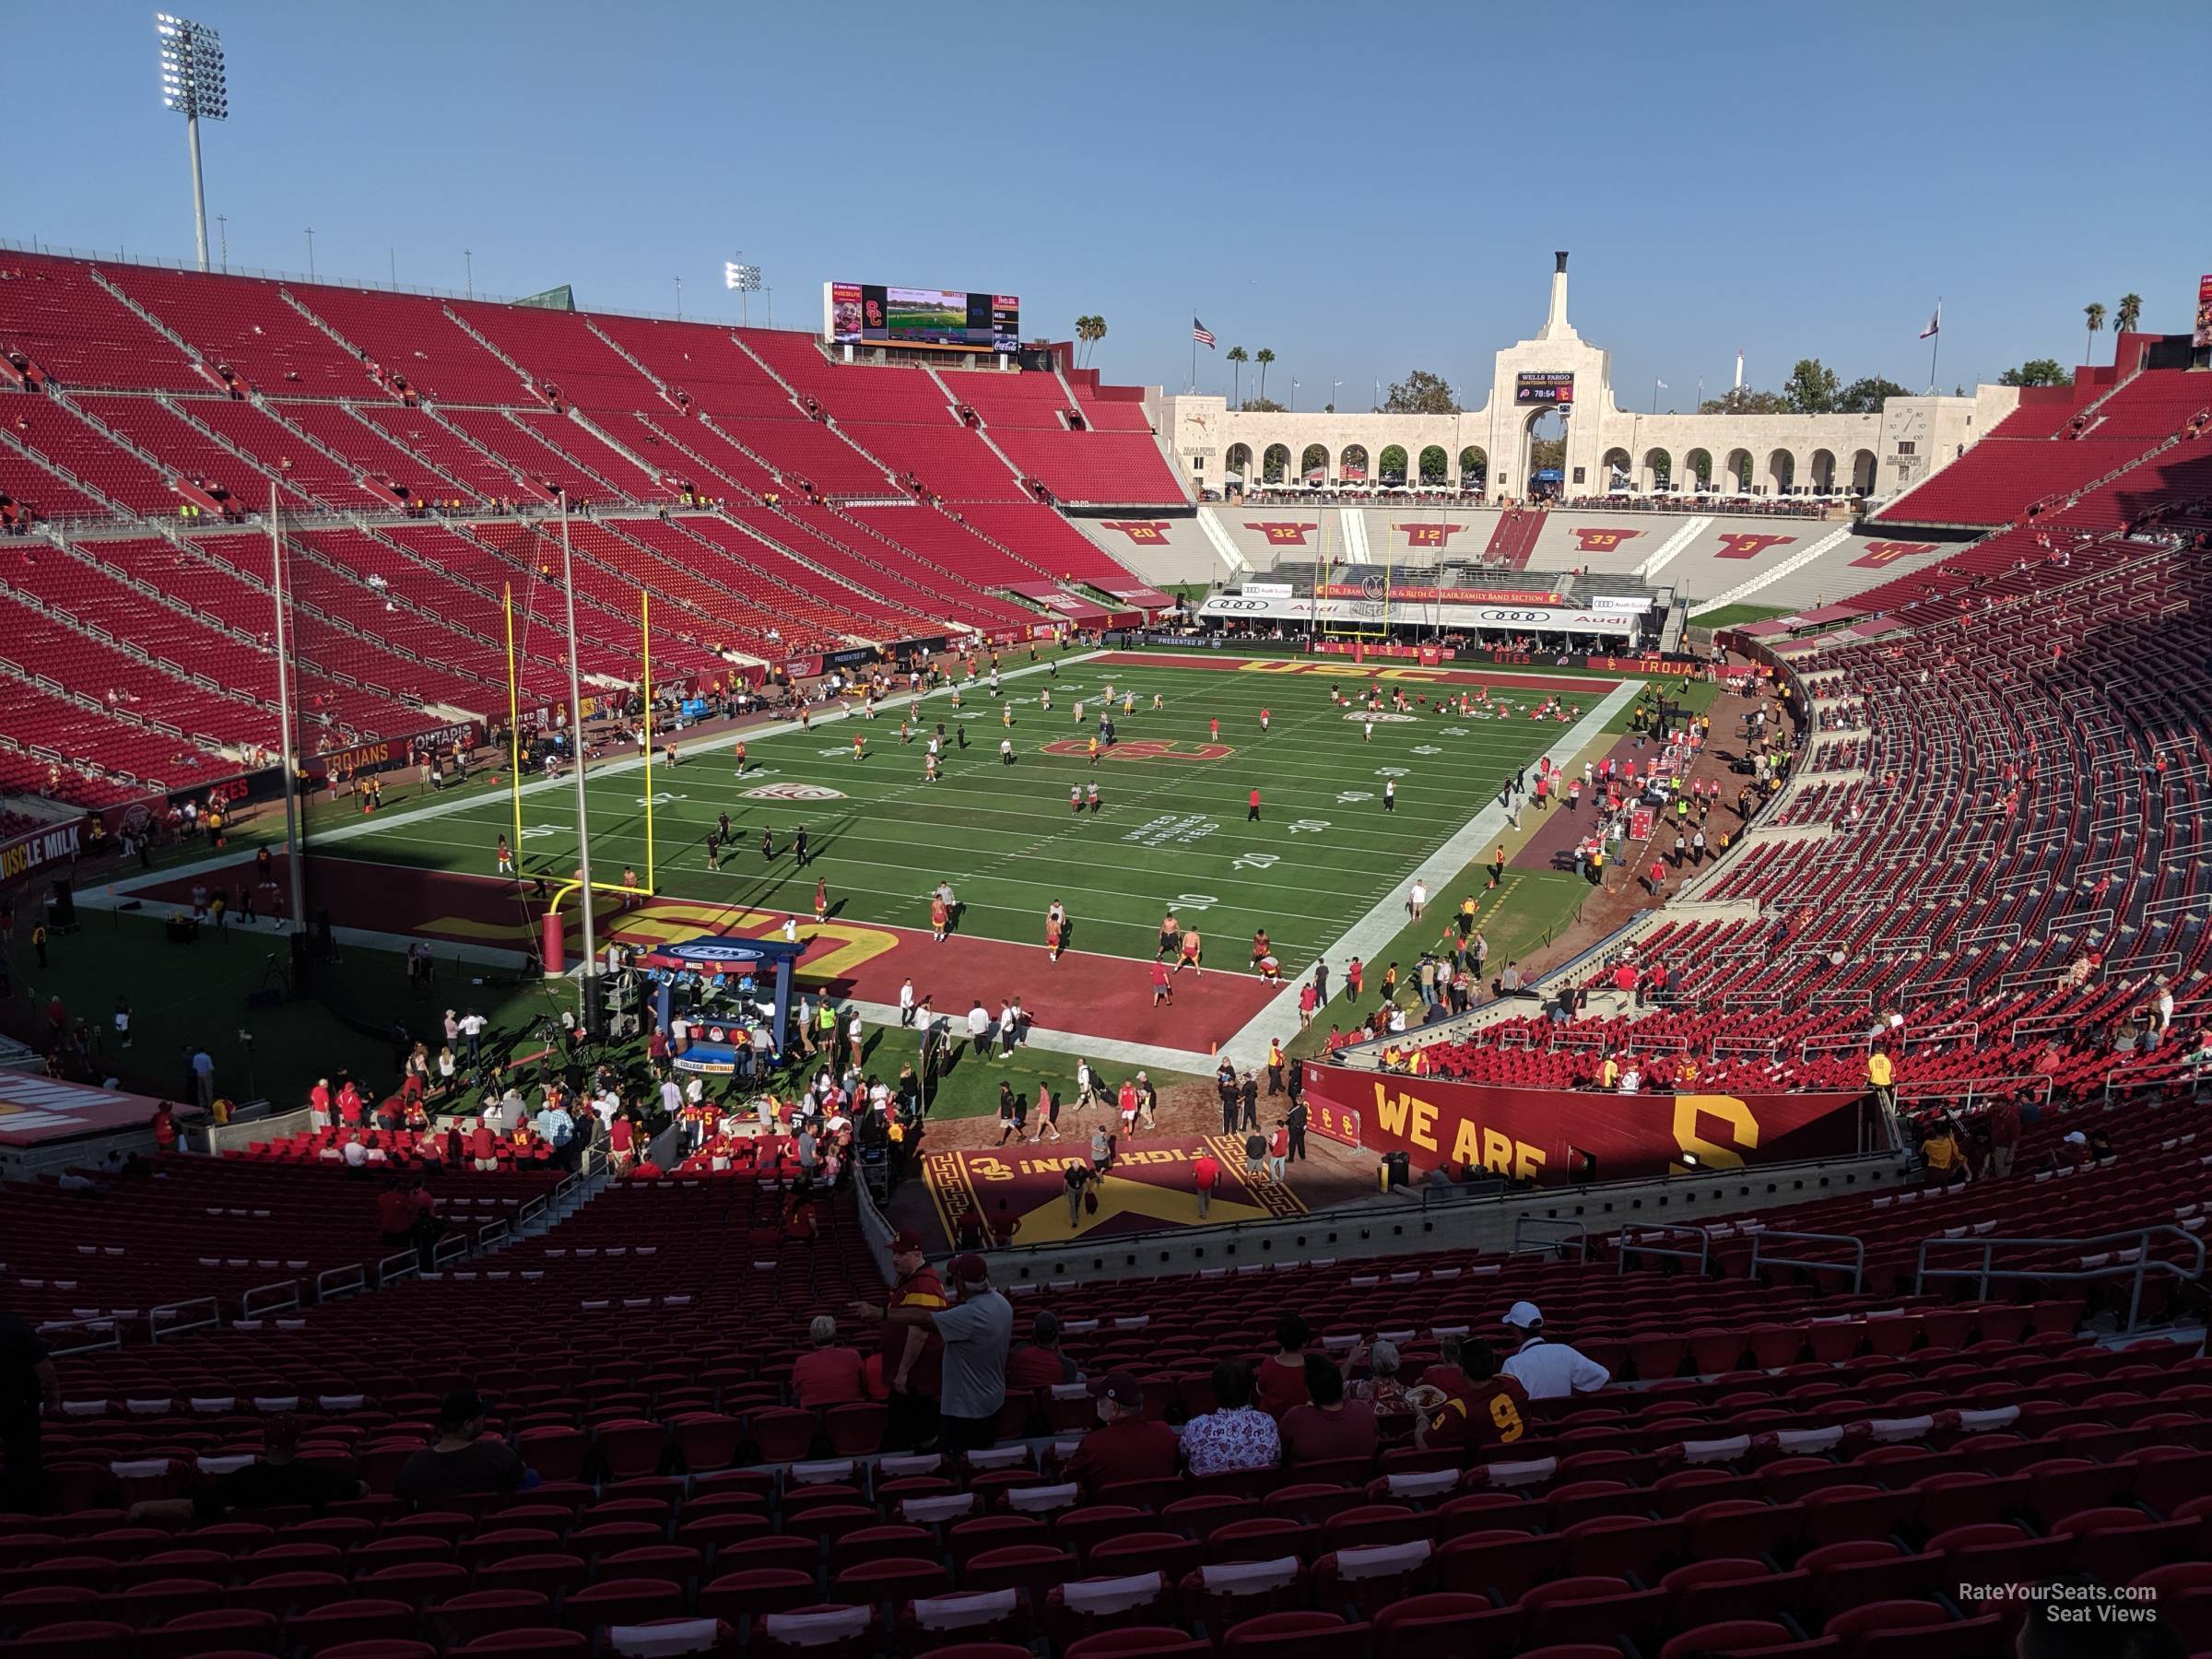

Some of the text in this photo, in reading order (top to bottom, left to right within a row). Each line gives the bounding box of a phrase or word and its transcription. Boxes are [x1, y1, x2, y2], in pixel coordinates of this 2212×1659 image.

[1534, 389, 1555, 397] 78:54
[1129, 527, 1157, 538] 20
[1270, 527, 1295, 538] 32
[1417, 528, 1441, 540] 12
[1587, 534, 1616, 545] 33
[1738, 541, 1755, 551] 3
[1351, 600, 1397, 617] Allstate
[1574, 616, 1628, 624] Audi
[1159, 638, 1196, 646] PRESENTED
[835, 653, 860, 663] PRESENTED
[1494, 653, 1530, 664] UTES
[1239, 661, 1450, 681] USC
[1640, 660, 1692, 675] TROJA
[324, 743, 388, 772] TROJANS
[1121, 815, 1177, 841] UNITED
[1143, 814, 1207, 847] AIRLINES
[1288, 818, 1332, 832] 30
[1177, 823, 1220, 843] FIELD
[44, 826, 81, 862] MILK
[1232, 853, 1280, 869] 20
[1166, 893, 1218, 911] 10
[680, 1061, 703, 1070] COLLEGE
[704, 1112, 712, 1125] 5
[792, 1118, 803, 1128] 33
[1322, 1108, 1333, 1128] SC
[1342, 1115, 1353, 1135] SC
[1374, 1081, 1439, 1152] WE
[1452, 1117, 1547, 1181] ARE
[512, 1133, 528, 1146] 14
[1112, 1146, 1214, 1168] FIGHT
[970, 1156, 1014, 1182] SC
[1431, 1412, 1445, 1430] 9
[1489, 1393, 1524, 1443] 9
